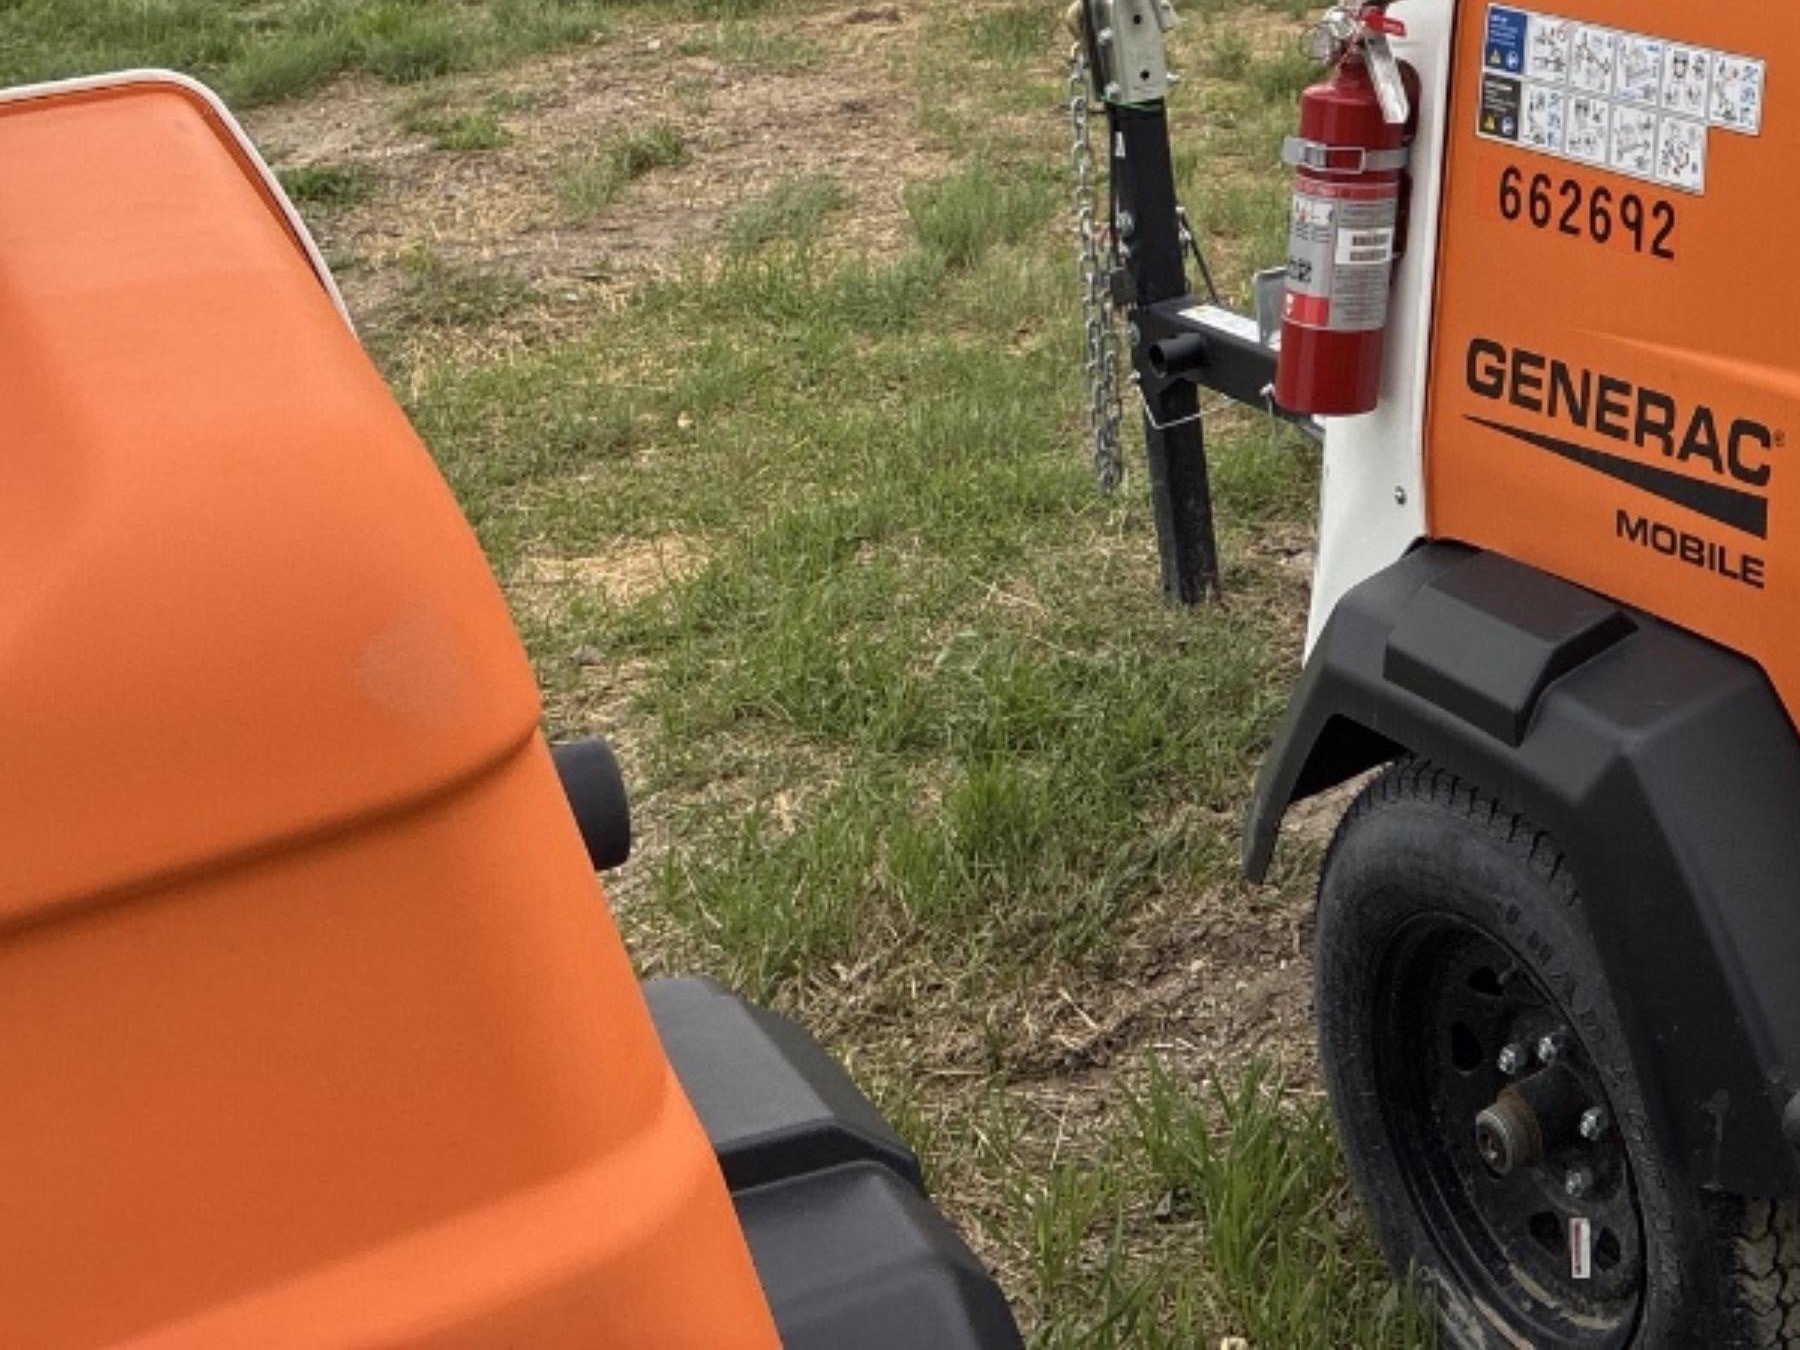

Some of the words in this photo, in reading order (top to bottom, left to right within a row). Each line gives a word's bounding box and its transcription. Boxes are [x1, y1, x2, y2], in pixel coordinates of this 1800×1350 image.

[1500, 165, 1675, 261] 662692
[1466, 337, 1771, 487] GENERAC
[1616, 509, 1766, 590] MOBILE
